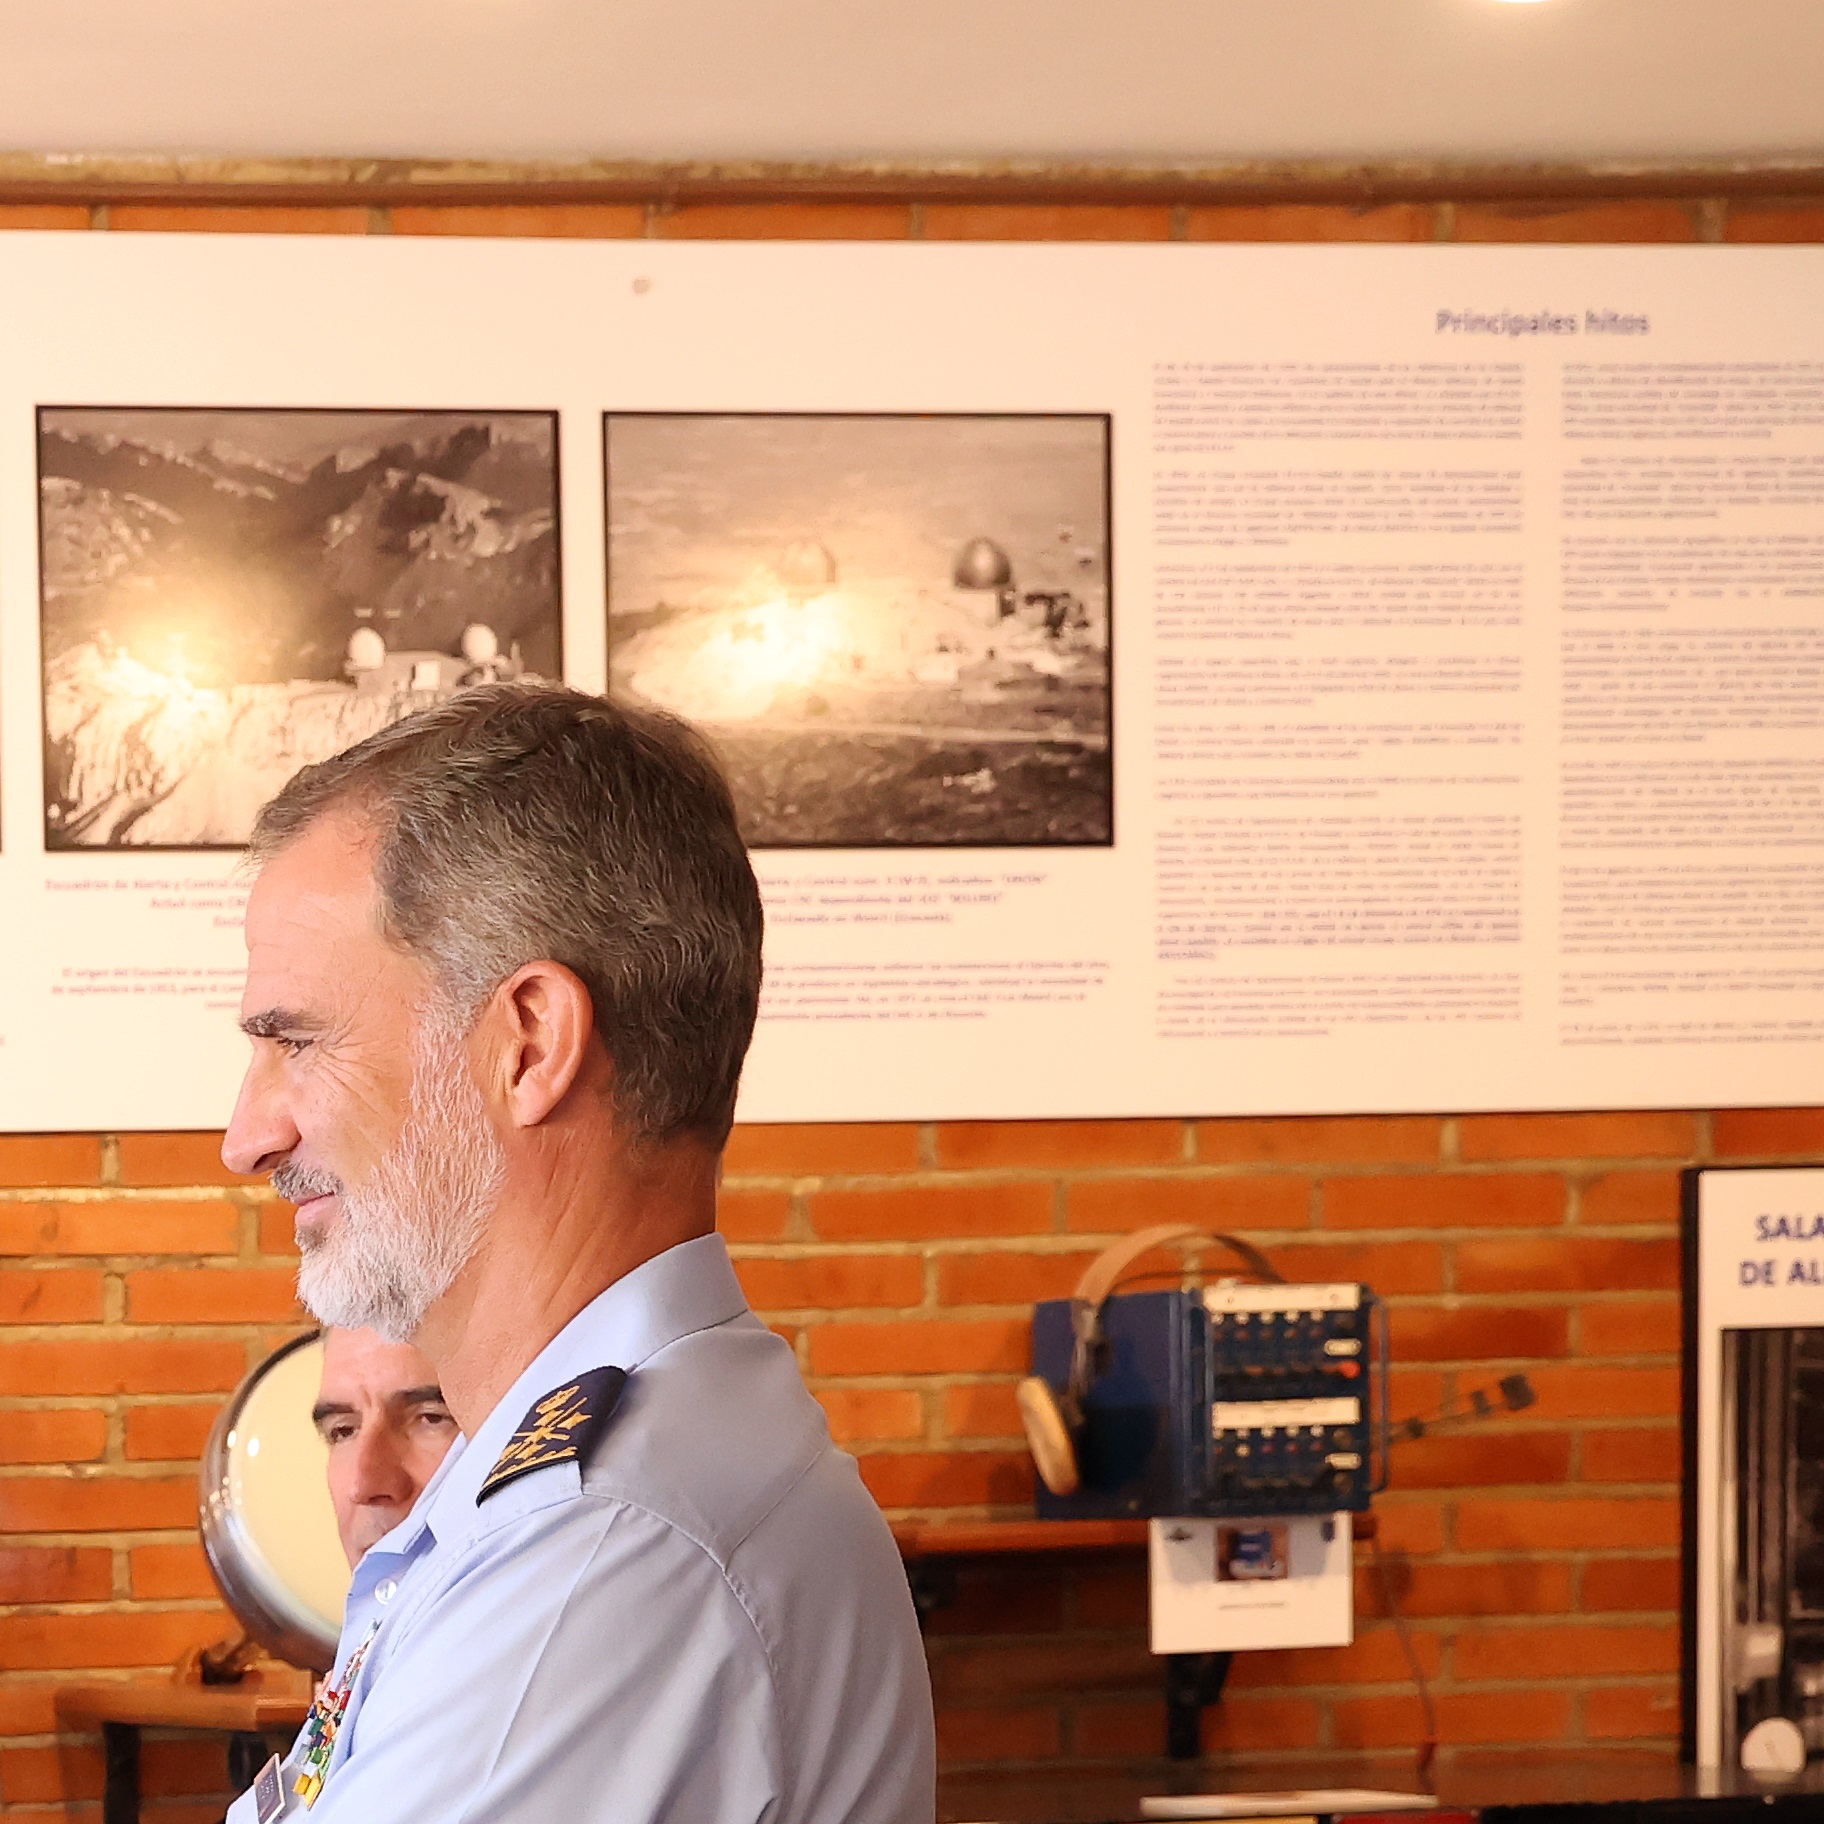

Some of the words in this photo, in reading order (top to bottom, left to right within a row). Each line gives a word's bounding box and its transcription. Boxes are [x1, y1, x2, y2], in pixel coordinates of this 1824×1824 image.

[1436, 309, 1579, 338] Principales
[1585, 309, 1651, 336] hitos
[1754, 1215, 1824, 1242] SALA
[1739, 1260, 1776, 1286] DE
[1786, 1260, 1824, 1286] AL
